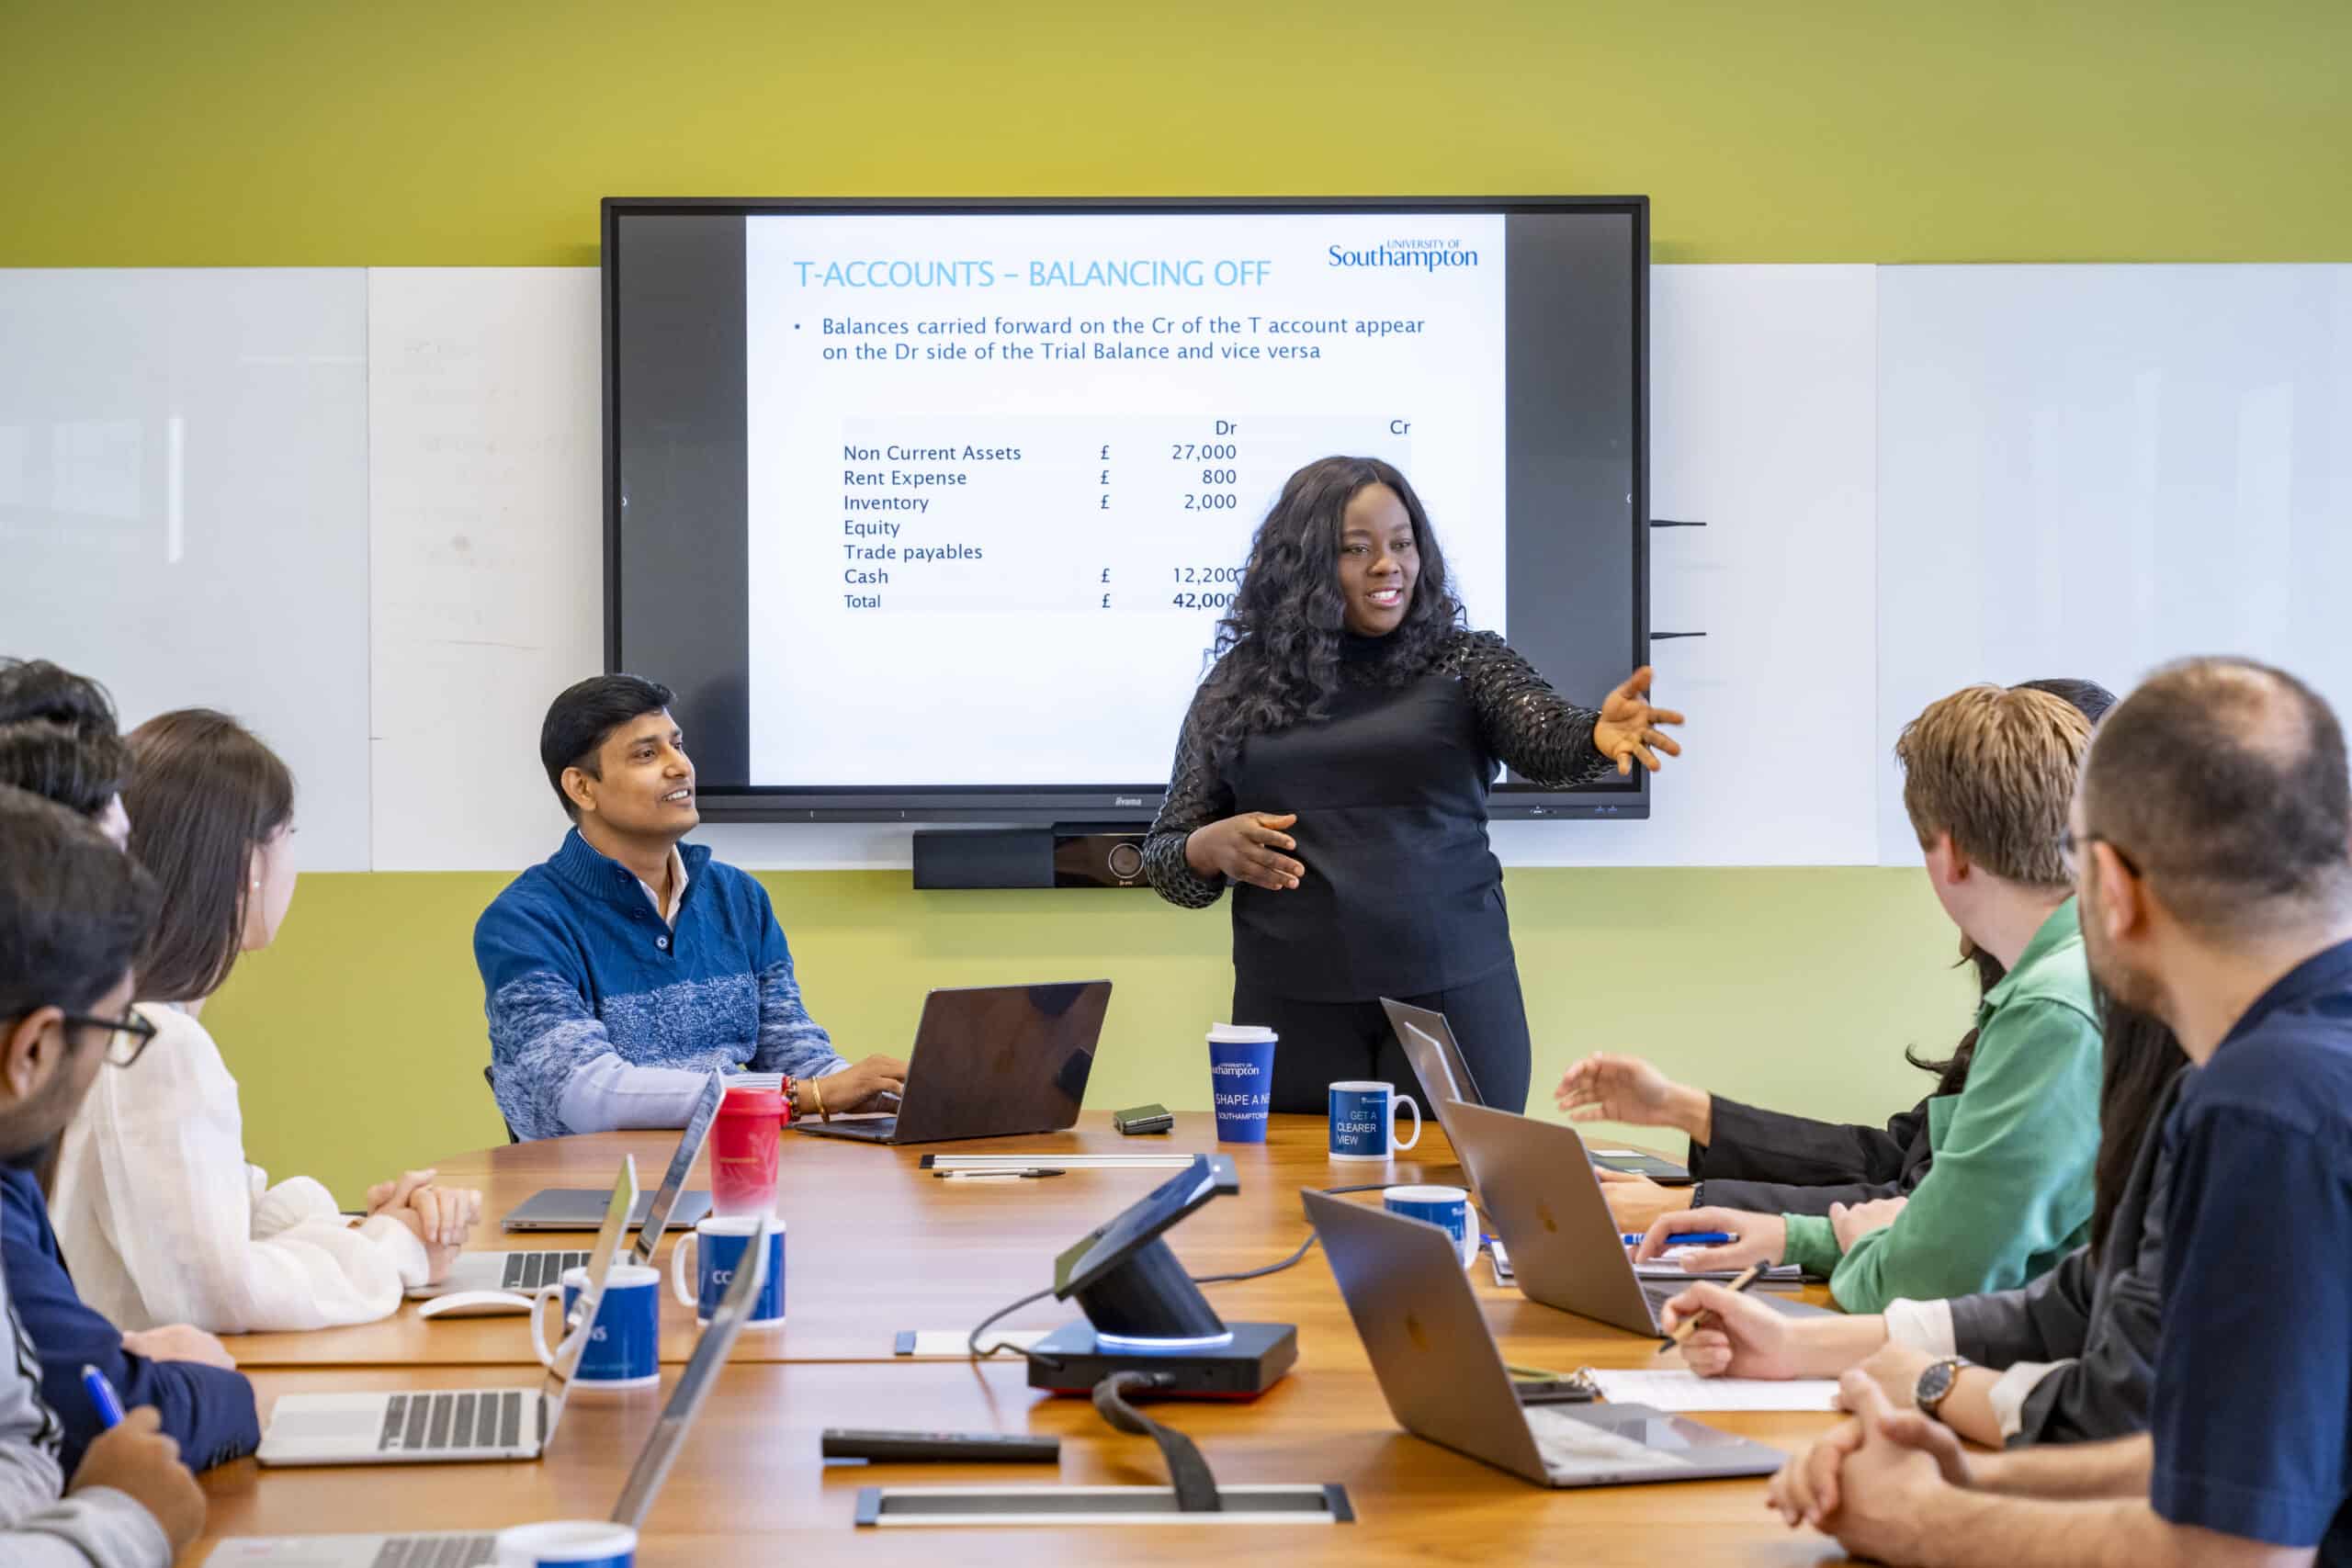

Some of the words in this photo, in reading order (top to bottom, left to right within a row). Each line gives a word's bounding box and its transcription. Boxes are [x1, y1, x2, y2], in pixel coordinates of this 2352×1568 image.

[1386, 239, 1444, 249] UNIVERSITY
[1448, 239, 1462, 248] OF
[1329, 244, 1478, 273] Southampton
[793, 261, 994, 287] T-ACCOUNTS
[1030, 261, 1204, 287] BALANCING
[1215, 261, 1272, 287] OFF
[823, 317, 909, 334] Balances
[917, 317, 986, 335] carried
[995, 316, 1071, 334] forward
[1080, 321, 1104, 334] on
[1113, 316, 1144, 333] the
[1152, 317, 1175, 333] Cr
[1182, 316, 1203, 333] of
[1209, 316, 1240, 333] the
[1248, 317, 1261, 333] T
[1269, 319, 1348, 333] account
[1355, 321, 1425, 338] appear
[823, 346, 847, 360] on
[855, 343, 887, 360] the
[896, 344, 919, 360] Dr
[926, 342, 967, 360] side
[975, 342, 996, 360] of
[1002, 342, 1034, 359] the
[1040, 342, 1085, 360] Trial
[1094, 342, 1169, 359] Balance
[1178, 341, 1213, 359] and
[1221, 342, 1260, 359] vice
[1268, 346, 1320, 359] versa
[1216, 421, 1238, 436] Dr
[1389, 420, 1411, 435] Cr
[844, 446, 880, 461] Non
[888, 446, 956, 461] Current
[963, 446, 1022, 461] Assets
[1101, 445, 1110, 460] £
[1172, 445, 1237, 463] 27,000
[844, 470, 885, 486] Rent
[892, 470, 967, 489] Expense
[1101, 469, 1110, 485] £
[1203, 469, 1237, 485] 800
[844, 495, 929, 513] Inventory
[1101, 494, 1110, 510] £
[1184, 494, 1237, 513] 2,000
[844, 519, 900, 538] Equity
[843, 544, 896, 559] Trade
[904, 544, 982, 563] payables
[844, 568, 888, 584] Cash
[1101, 568, 1110, 583] £
[1174, 567, 1237, 585] 12,200
[843, 593, 881, 608] Total
[1102, 593, 1110, 608] £
[1216, 1093, 1250, 1106] SHAPE
[1251, 1093, 1259, 1106] A
[1351, 1110, 1368, 1121] GET
[1371, 1111, 1377, 1120] A
[1337, 1122, 1376, 1133] CLEARER
[1337, 1134, 1359, 1146] VIEW
